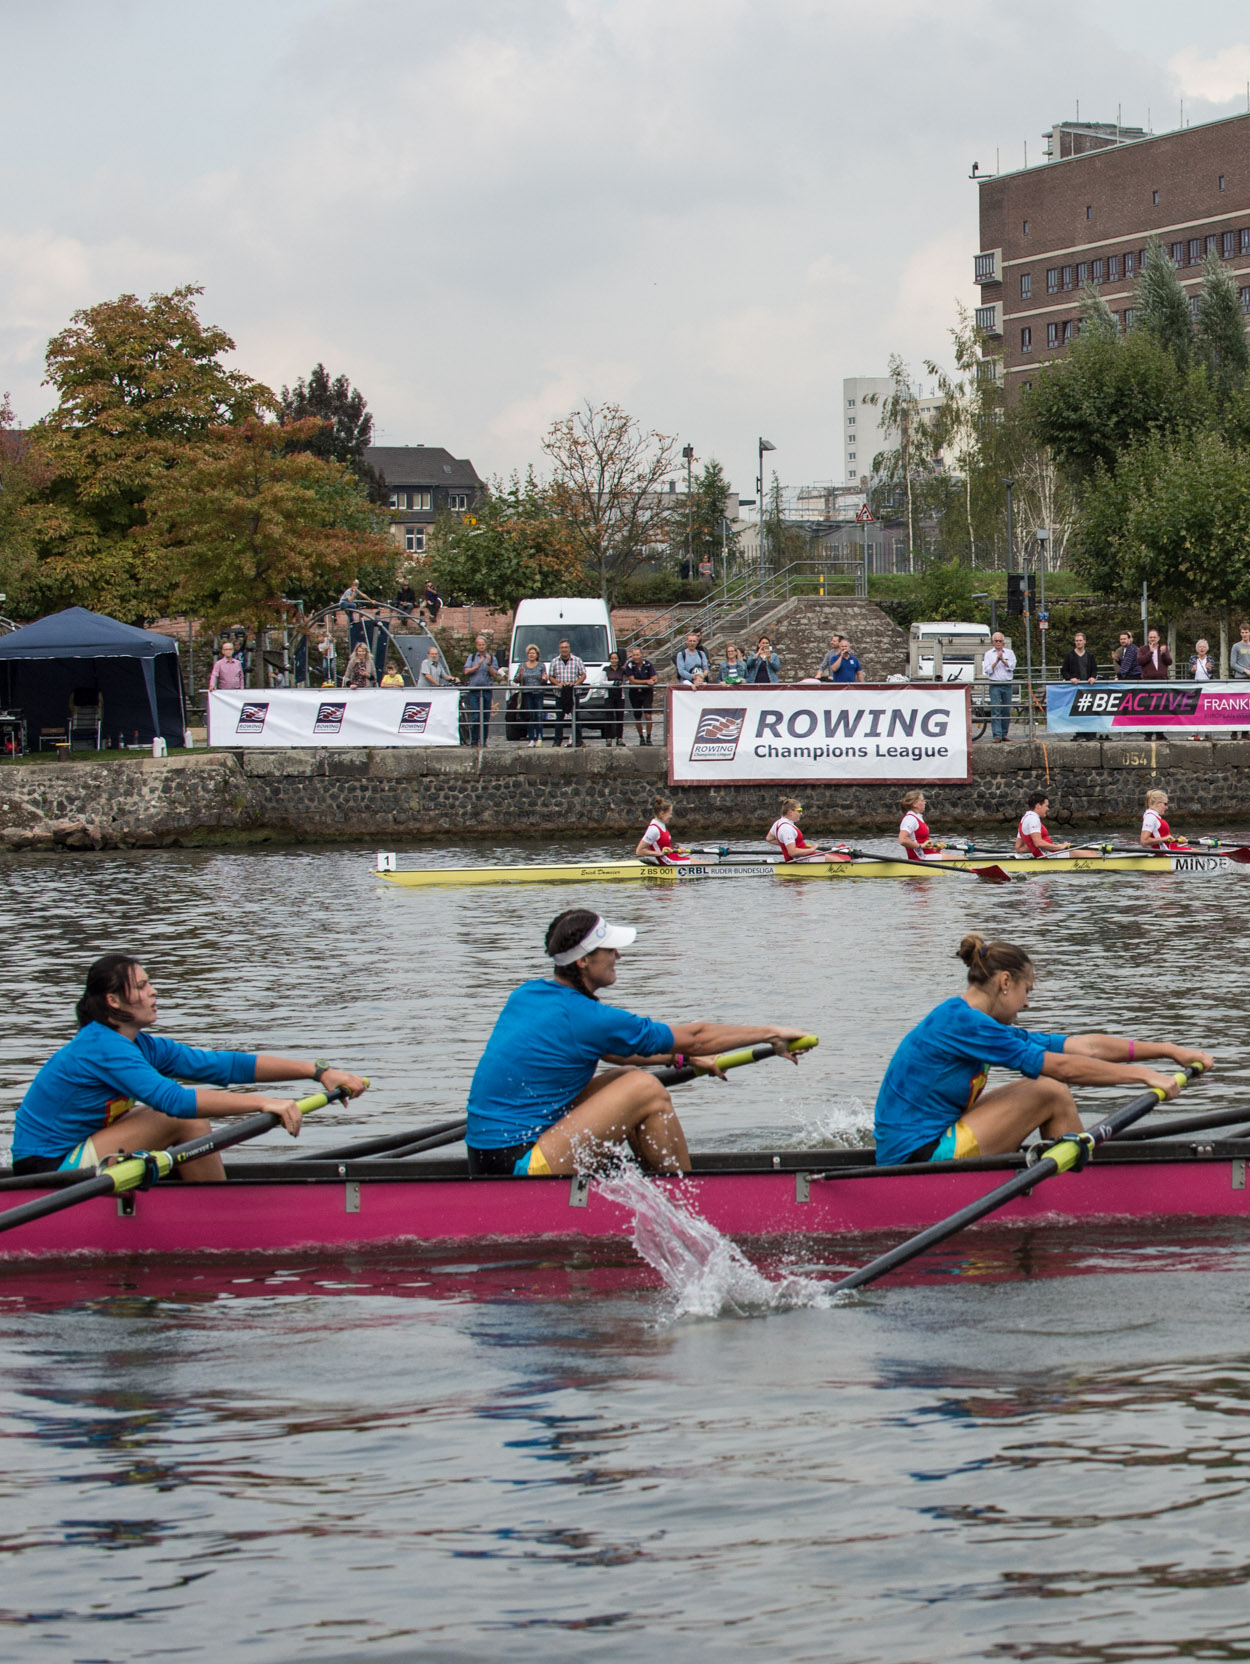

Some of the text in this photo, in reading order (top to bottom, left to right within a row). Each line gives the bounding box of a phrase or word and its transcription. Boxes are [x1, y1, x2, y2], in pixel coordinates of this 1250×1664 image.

[1077, 692, 1197, 712] #BEACTIVE
[755, 708, 951, 739] ROWING
[694, 745, 734, 753] ROWING
[754, 744, 949, 761] Champions League
[384, 855, 390, 867] 1
[1175, 858, 1228, 871] MINDE
[688, 867, 709, 875] RBL
